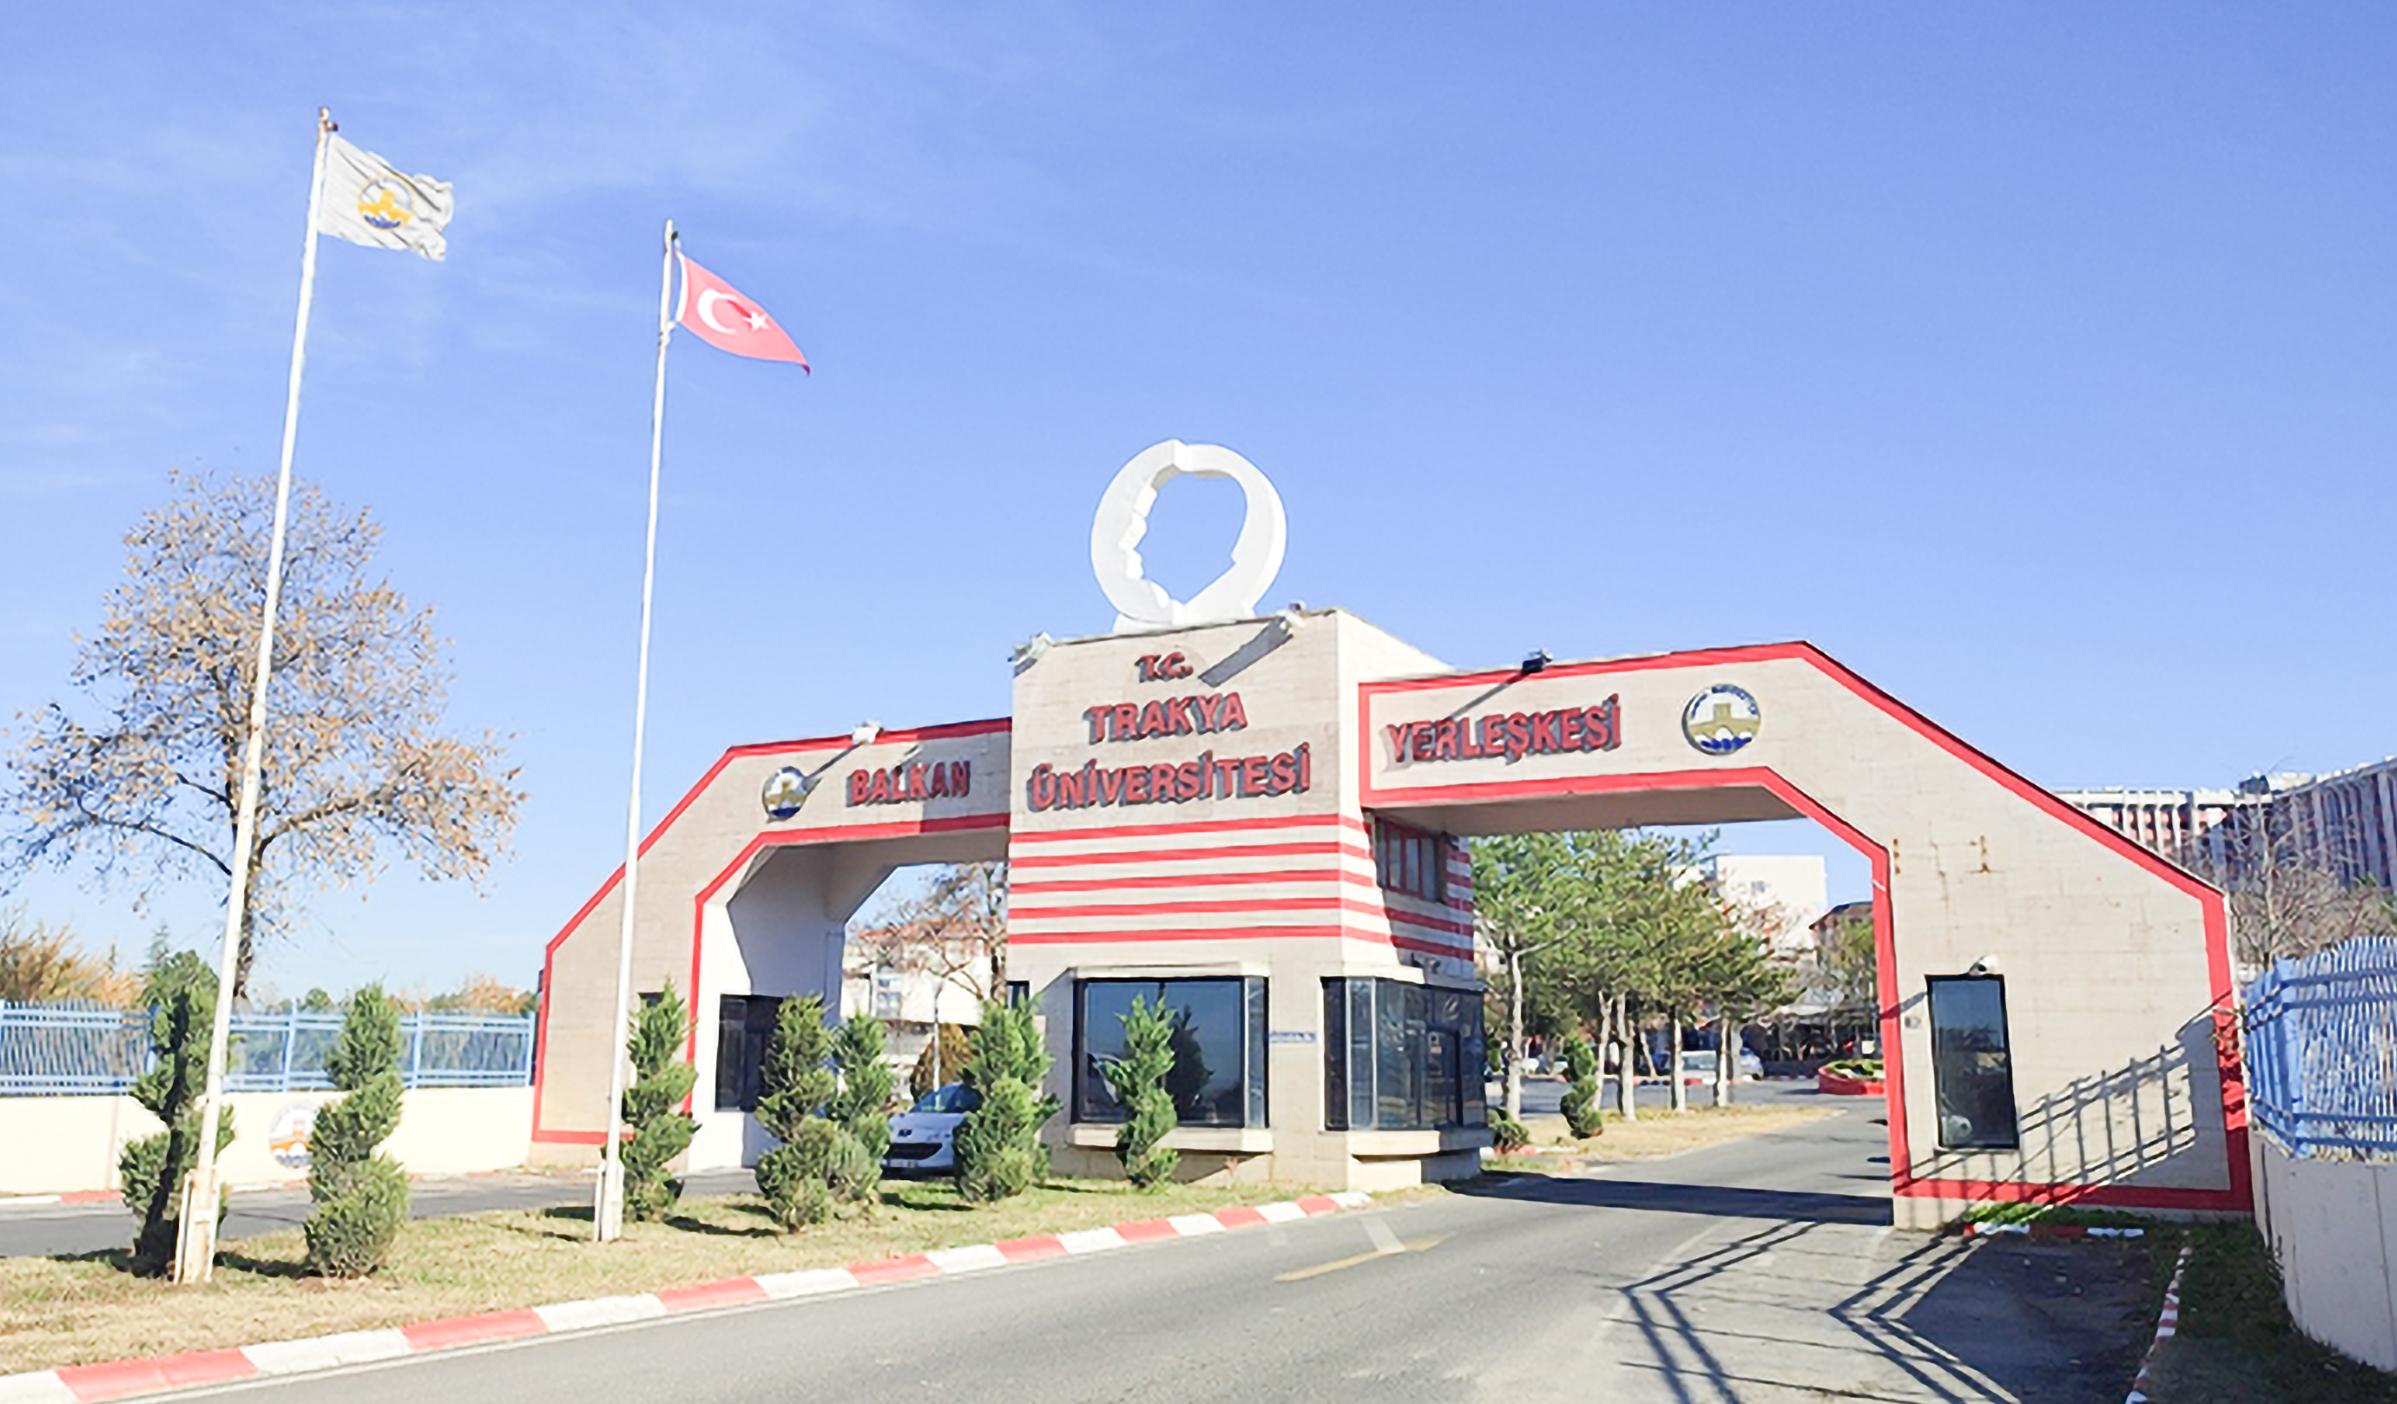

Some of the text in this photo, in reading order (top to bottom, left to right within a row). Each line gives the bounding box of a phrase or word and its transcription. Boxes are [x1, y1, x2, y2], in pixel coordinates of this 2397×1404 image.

[1088, 692, 1247, 742] TRAKYA
[1387, 693, 1622, 760] YERLEŞKESİ
[848, 760, 971, 806] BALKAN
[1030, 742, 1311, 810] ÜNİVERSİTESİ
